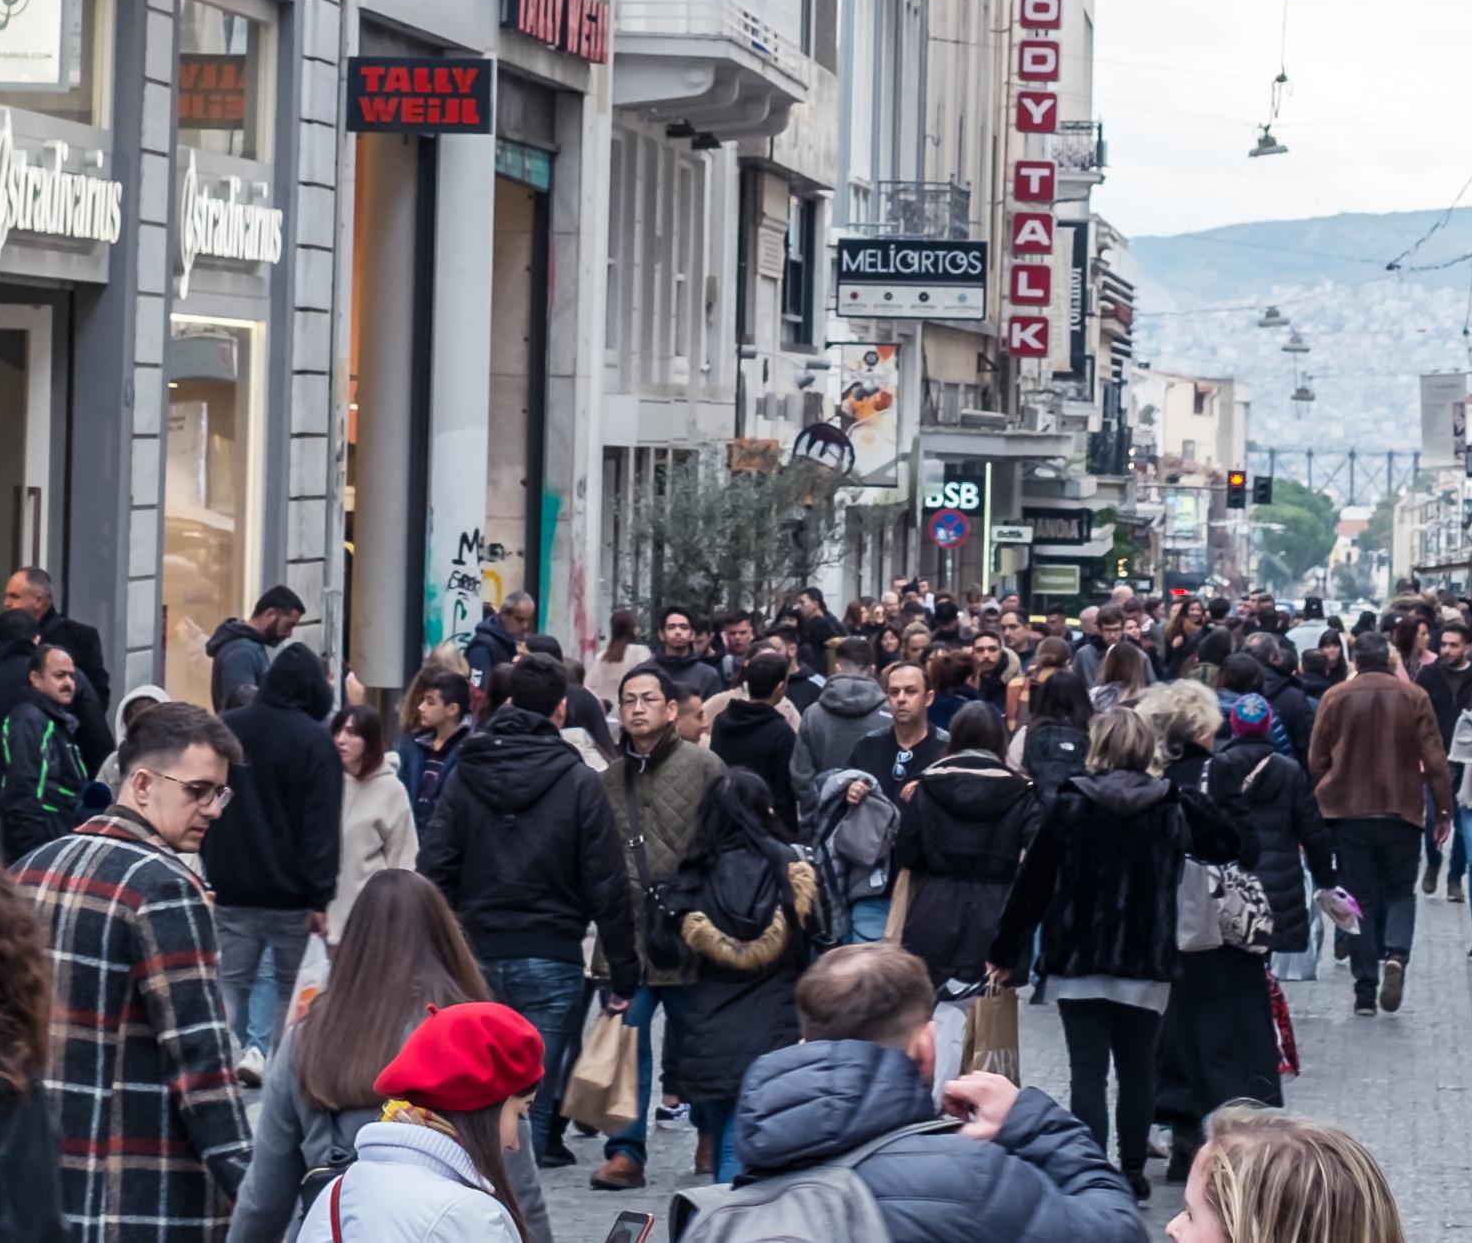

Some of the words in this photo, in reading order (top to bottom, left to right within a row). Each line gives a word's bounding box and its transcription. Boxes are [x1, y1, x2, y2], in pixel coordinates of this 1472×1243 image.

[360, 66, 480, 94] TALLY
[186, 169, 284, 267] stradivarius
[1009, 168, 1051, 350] TALK
